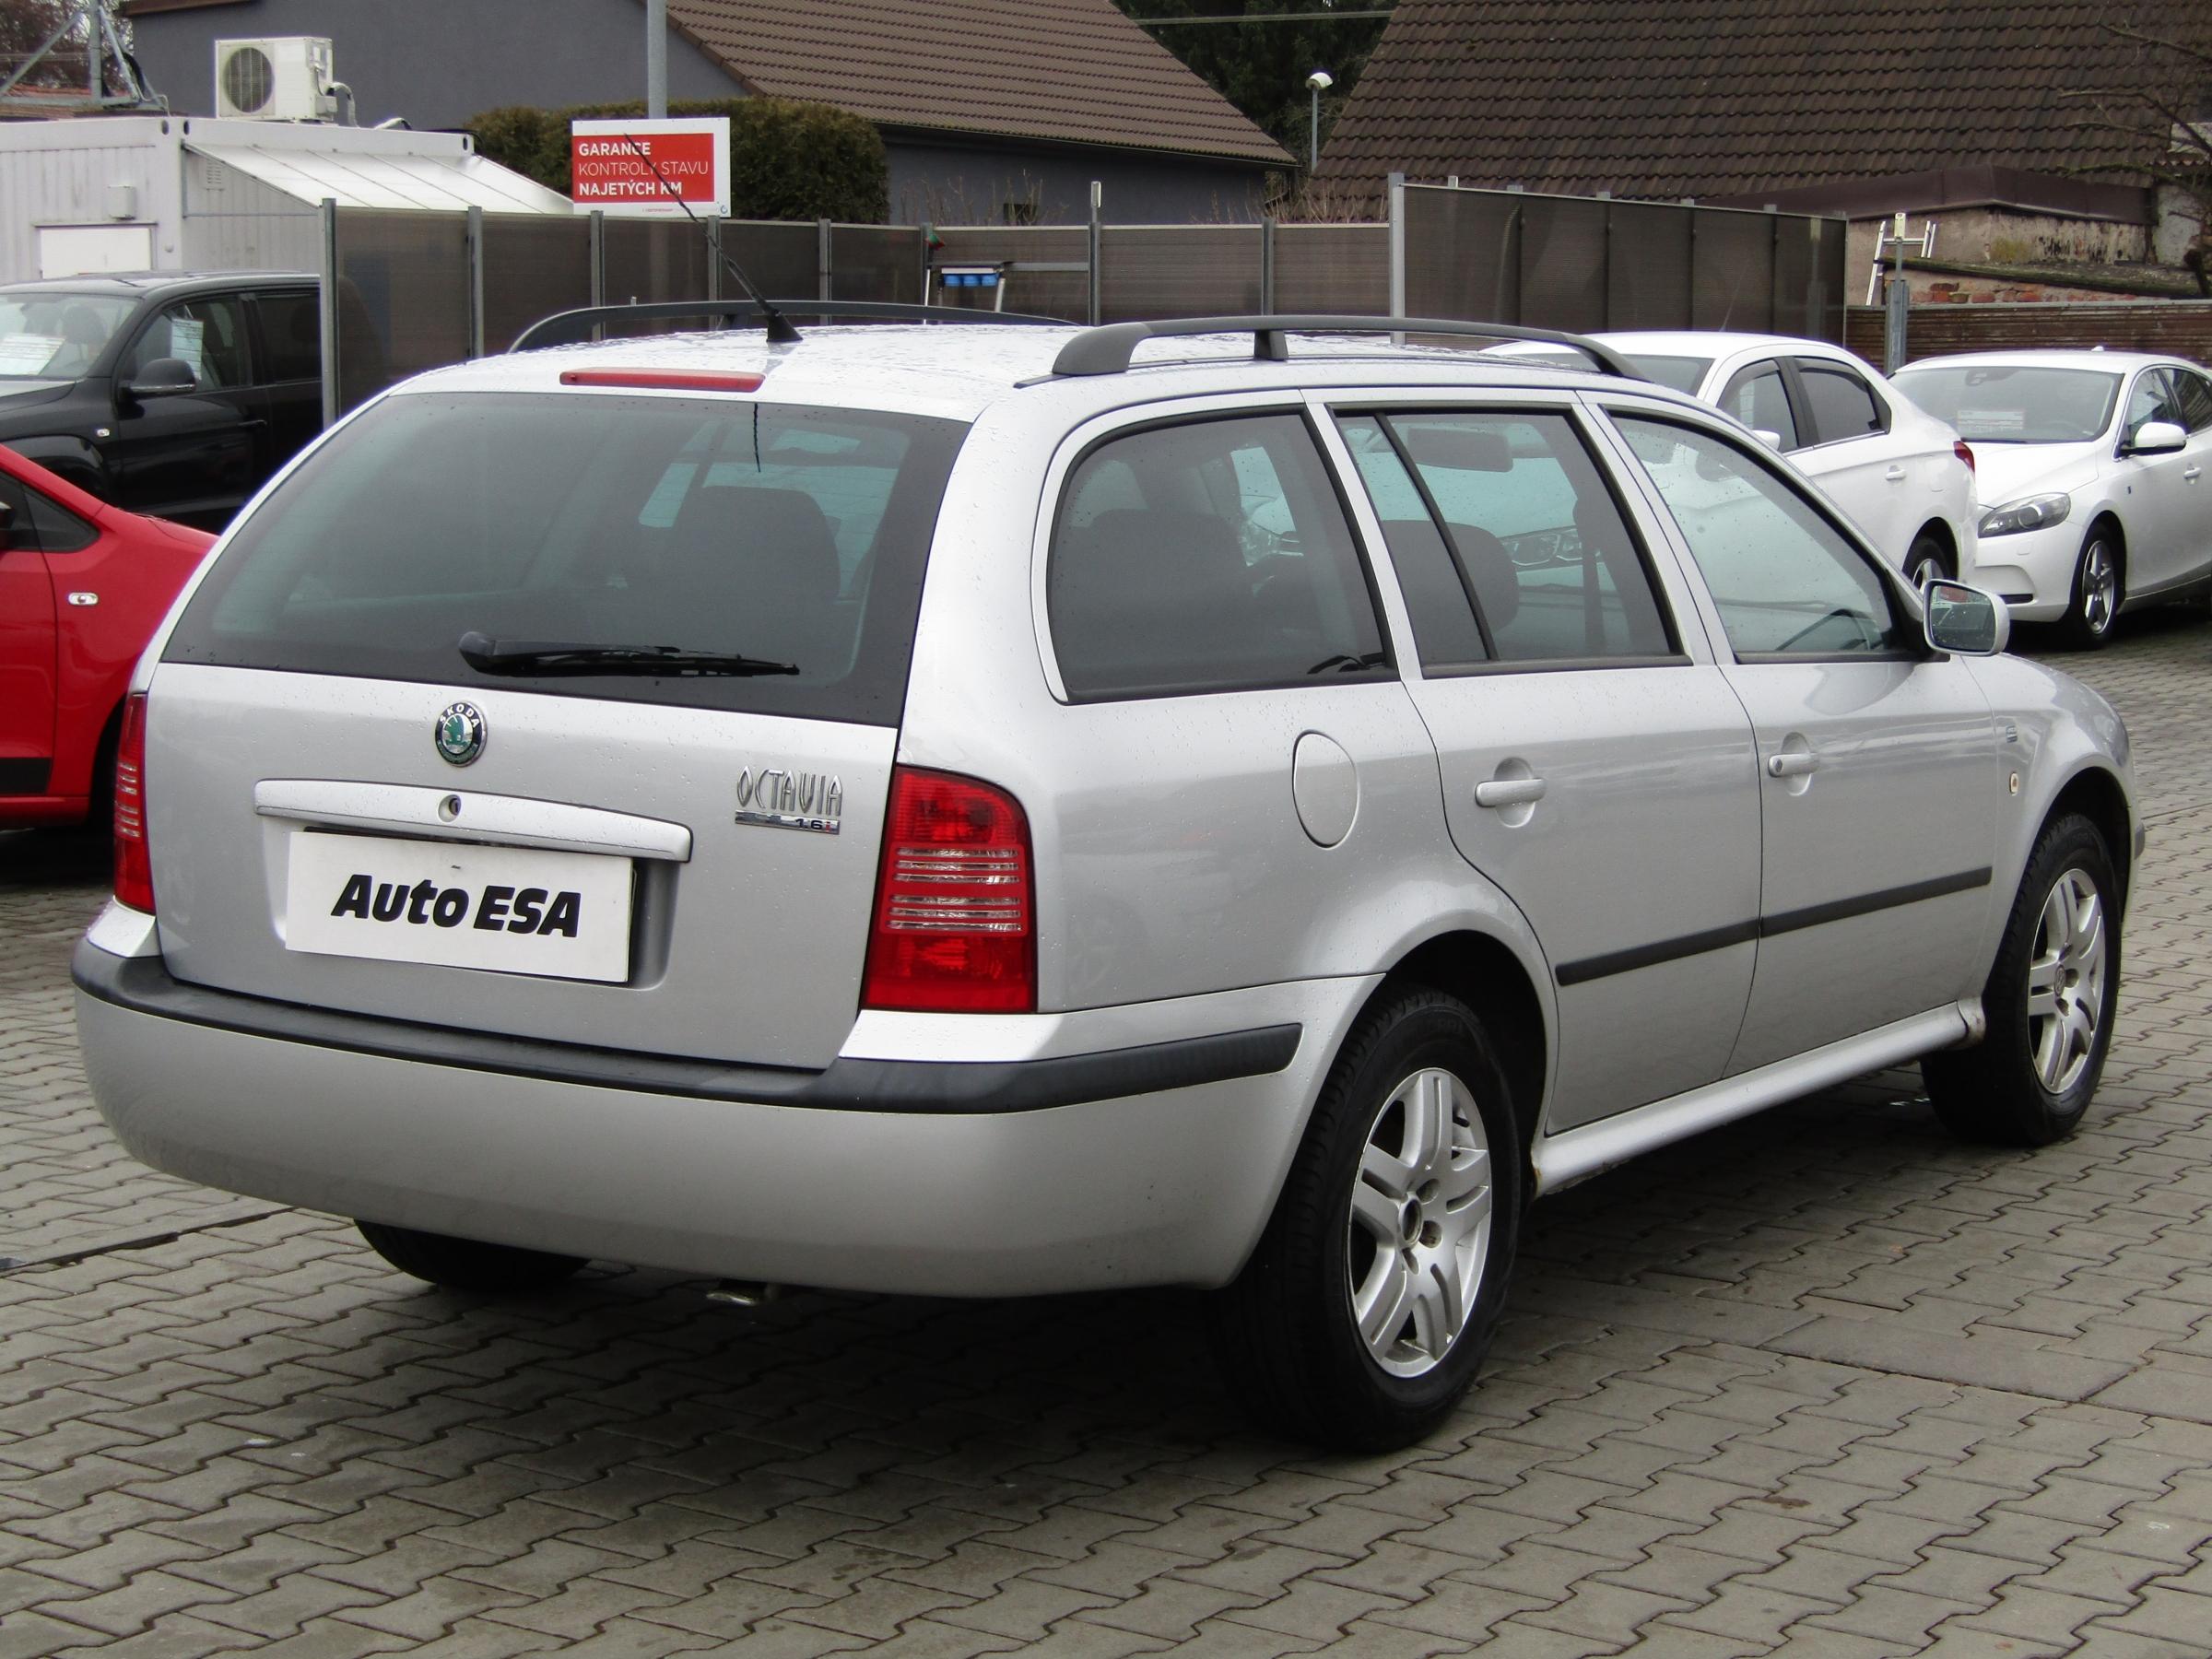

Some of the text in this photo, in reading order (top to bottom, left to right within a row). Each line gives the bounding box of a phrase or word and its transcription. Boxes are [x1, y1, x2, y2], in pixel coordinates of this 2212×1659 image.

[579, 142, 651, 156] GARANCE
[578, 161, 709, 176] KONTROLY STAVU
[579, 179, 682, 195] NAJETÝCH KM
[737, 765, 842, 817] OCTAVIA
[330, 874, 582, 938] Auto ESA
